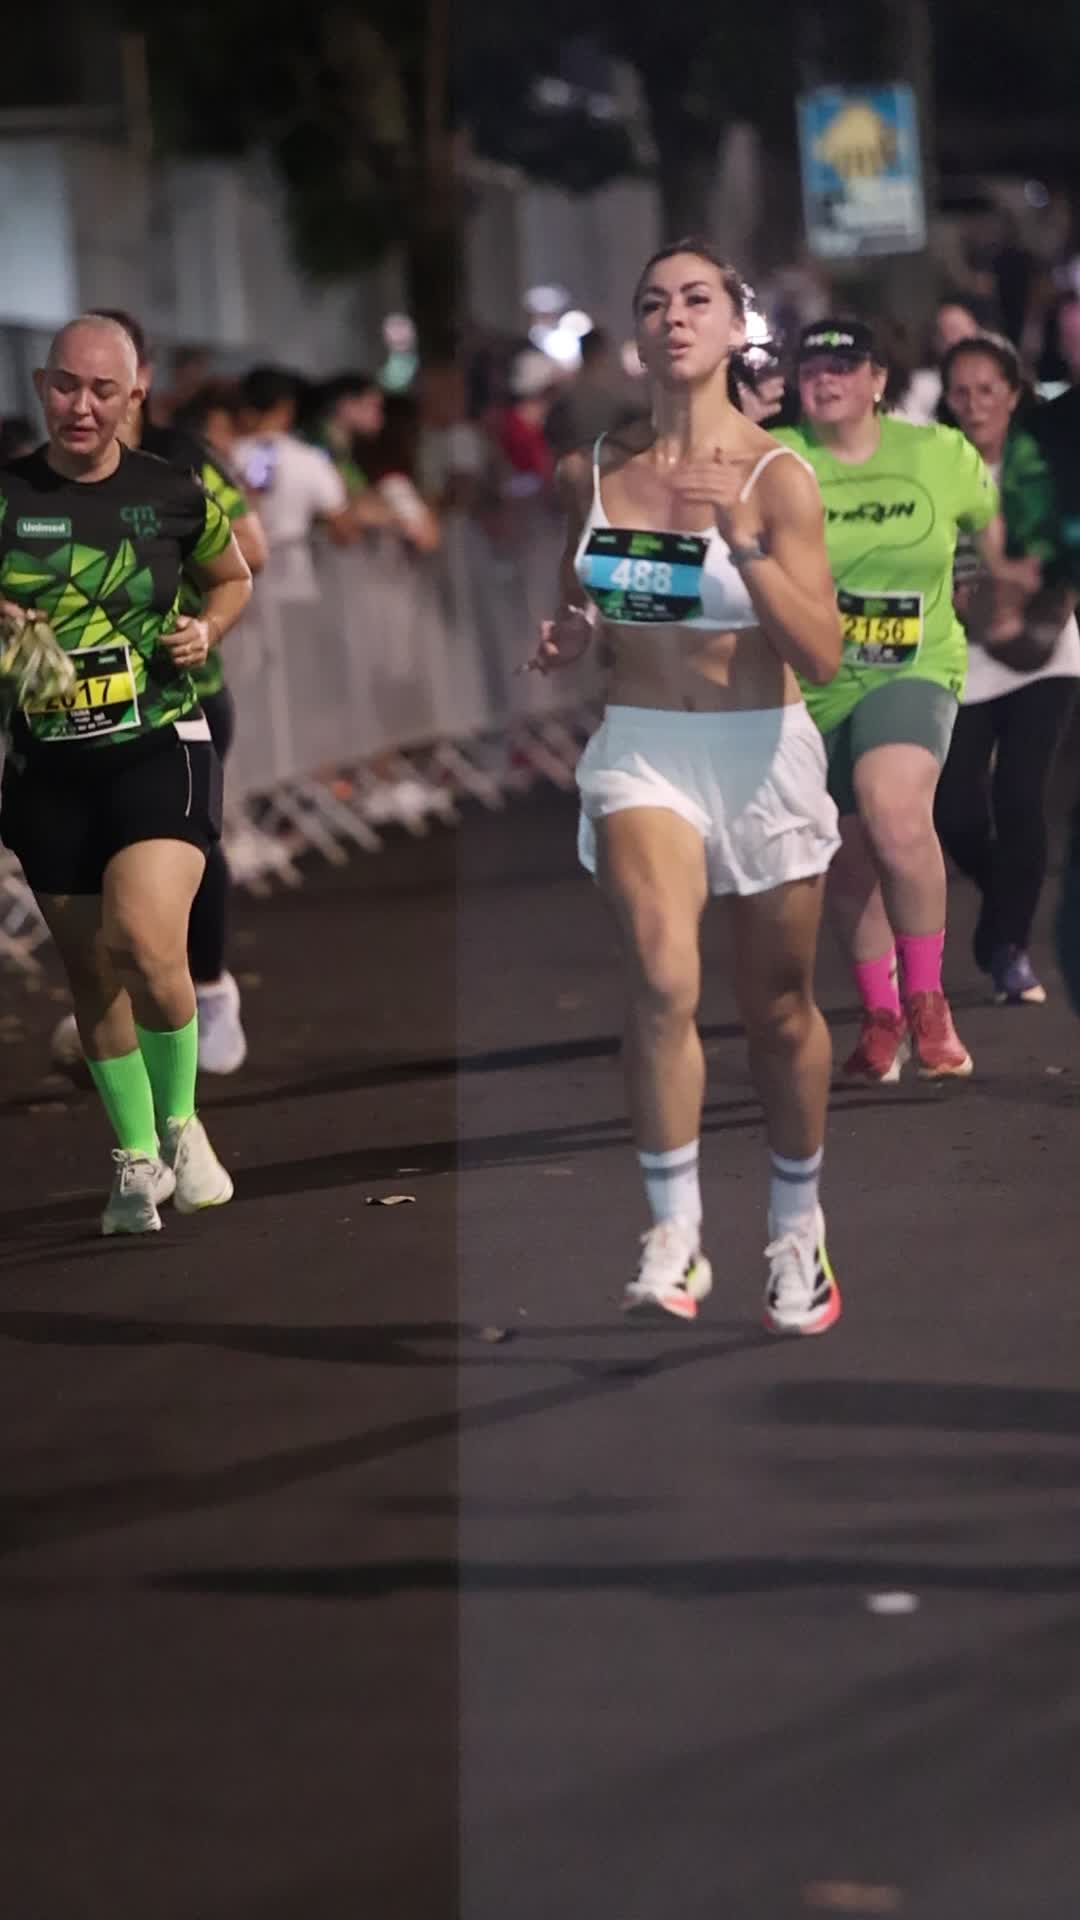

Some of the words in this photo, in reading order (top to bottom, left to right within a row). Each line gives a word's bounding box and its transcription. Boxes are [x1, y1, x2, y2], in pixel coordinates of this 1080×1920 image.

[22, 522, 66, 533] Unimed
[610, 558, 673, 594] 488
[844, 616, 905, 642] 2156
